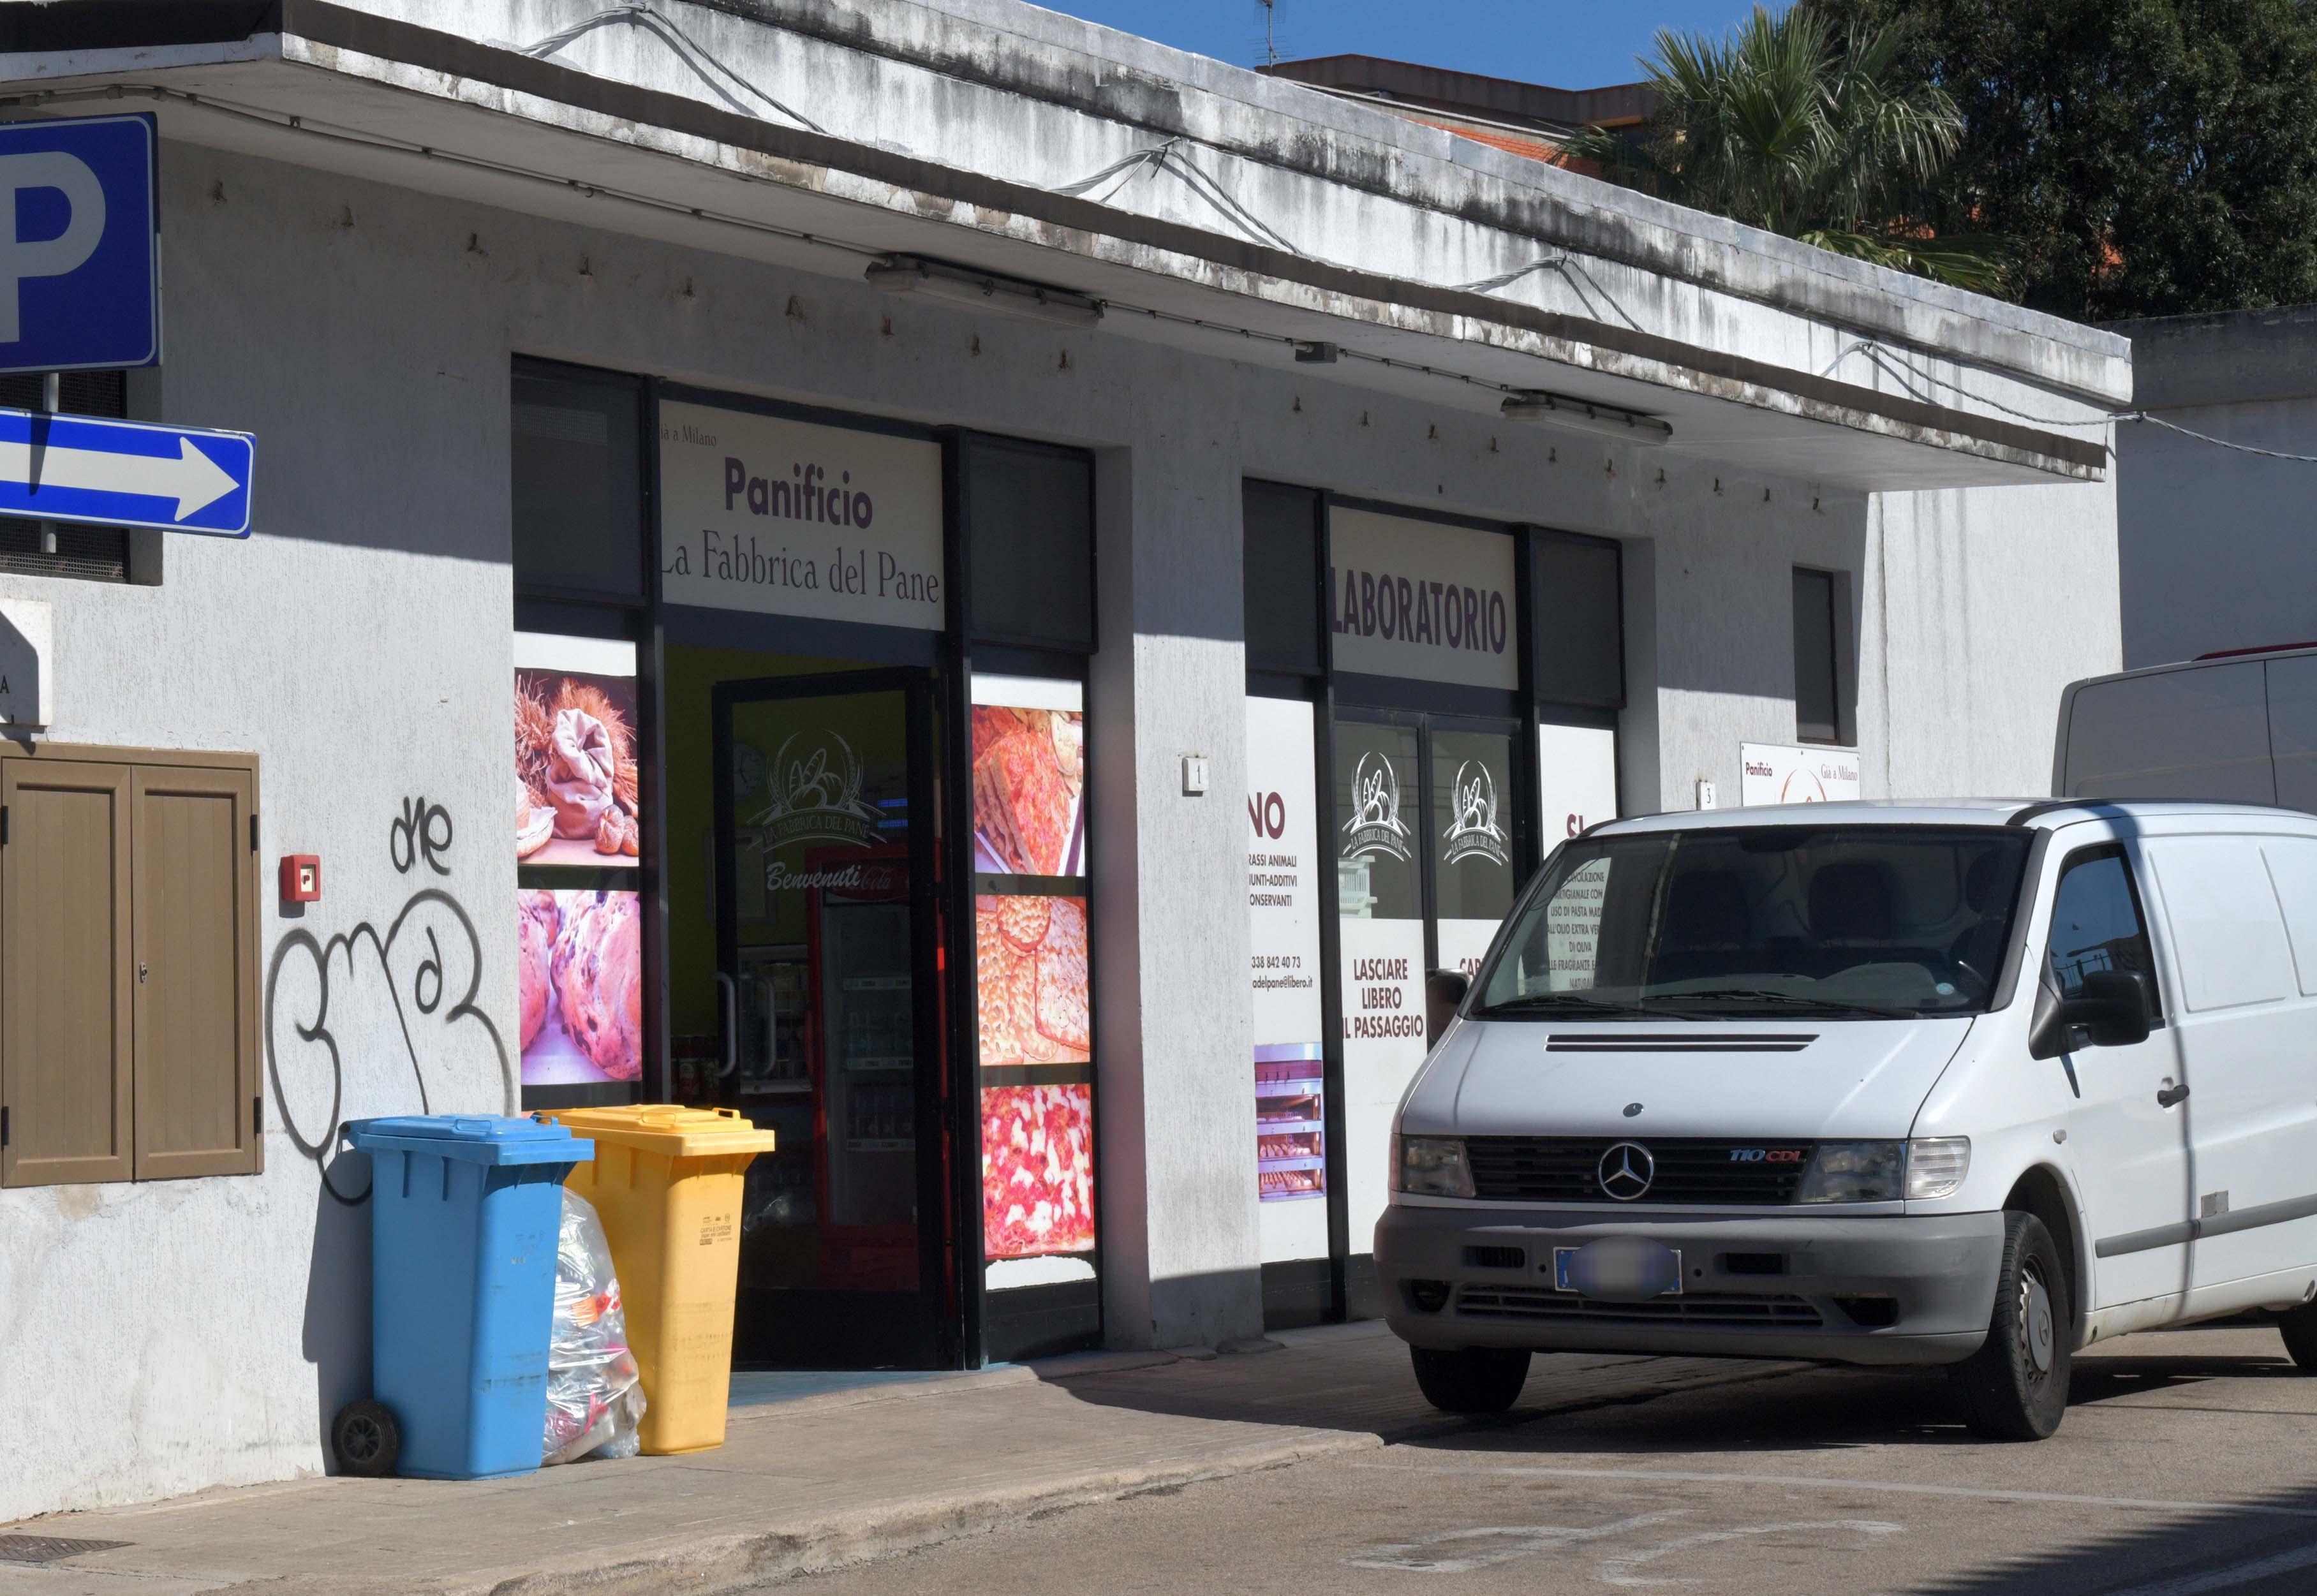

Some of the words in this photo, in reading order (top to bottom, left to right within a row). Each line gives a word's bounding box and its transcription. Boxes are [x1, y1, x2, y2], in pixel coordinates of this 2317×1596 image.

[0, 151, 105, 343] P
[681, 424, 716, 447] Milano
[725, 457, 873, 529] Panificio
[702, 530, 818, 589] Fabbrica
[829, 546, 866, 595] del
[878, 551, 939, 603] Pane
[1329, 565, 1506, 654] LABORATORIO
[1745, 762, 1773, 777] Panificio
[1821, 764, 1832, 779] Già
[1838, 765, 1858, 781] Milano
[1706, 788, 1712, 804] 3
[825, 816, 842, 830] DEL
[1248, 792, 1285, 839] NO
[1351, 836, 1358, 850] LA
[1358, 829, 1381, 845] FABBRICA
[1381, 829, 1390, 843] DEL
[1451, 841, 1458, 855] LA
[1458, 834, 1479, 851] FABBRICA
[1480, 835, 1488, 849] DEL
[1268, 855, 1297, 868] ANIMALI
[766, 861, 861, 890] Benvenuti
[1551, 906, 1562, 917] USO
[1564, 906, 1569, 917] DI
[1571, 906, 1587, 917] PASTA
[1571, 924, 1589, 935] EXTRA
[1569, 941, 1575, 952] DI
[1576, 942, 1592, 952] OLIVA
[1251, 956, 1264, 968] 338
[1266, 956, 1280, 968] 842
[1281, 956, 1291, 968] 40
[1292, 956, 1301, 968] 73
[1354, 959, 1408, 980] LASCIARE
[1558, 959, 1590, 971] FRAGRANTE
[1362, 987, 1402, 1009] LIBERO
[1354, 1014, 1423, 1038] PASSAGGIO
[1730, 1149, 1765, 1161] 110
[1765, 1150, 1800, 1162] CDI
